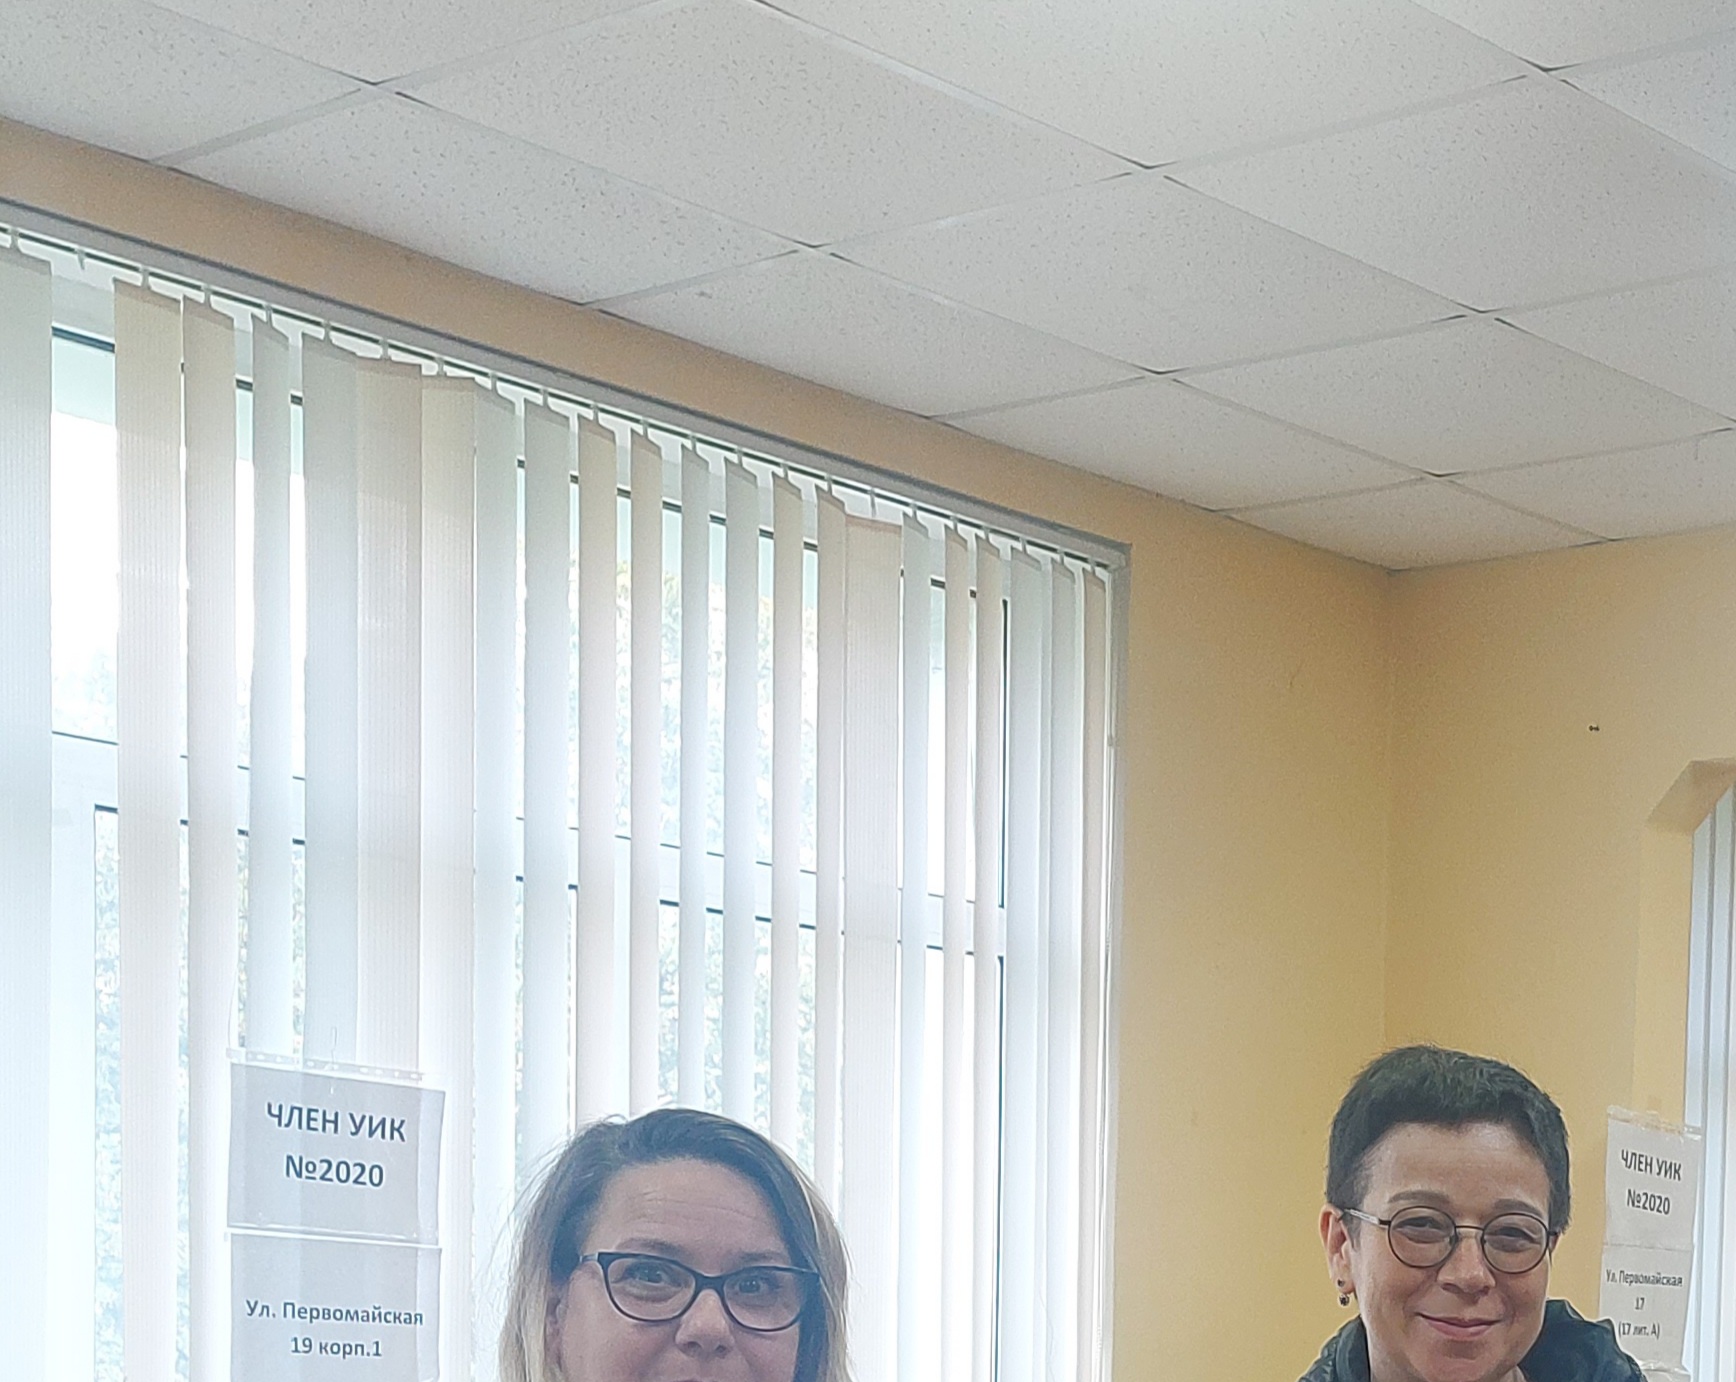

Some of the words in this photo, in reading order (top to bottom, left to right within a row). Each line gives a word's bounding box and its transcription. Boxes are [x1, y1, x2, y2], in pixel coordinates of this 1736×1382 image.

[267, 1102, 339, 1134] ЧЛЕН
[349, 1112, 406, 1142] УИК
[286, 1154, 384, 1187] №2020
[1621, 1149, 1653, 1175] ЧЛЕН
[1656, 1158, 1681, 1181] УИК
[1627, 1189, 1671, 1215] №2020
[1619, 1270, 1683, 1287] Первомайская
[246, 1300, 276, 1318] Ул.
[283, 1302, 423, 1325] Первомайская
[1635, 1297, 1645, 1310] 17
[1618, 1321, 1631, 1338] (17
[291, 1337, 313, 1354] 19
[319, 1340, 382, 1359] корп.1
